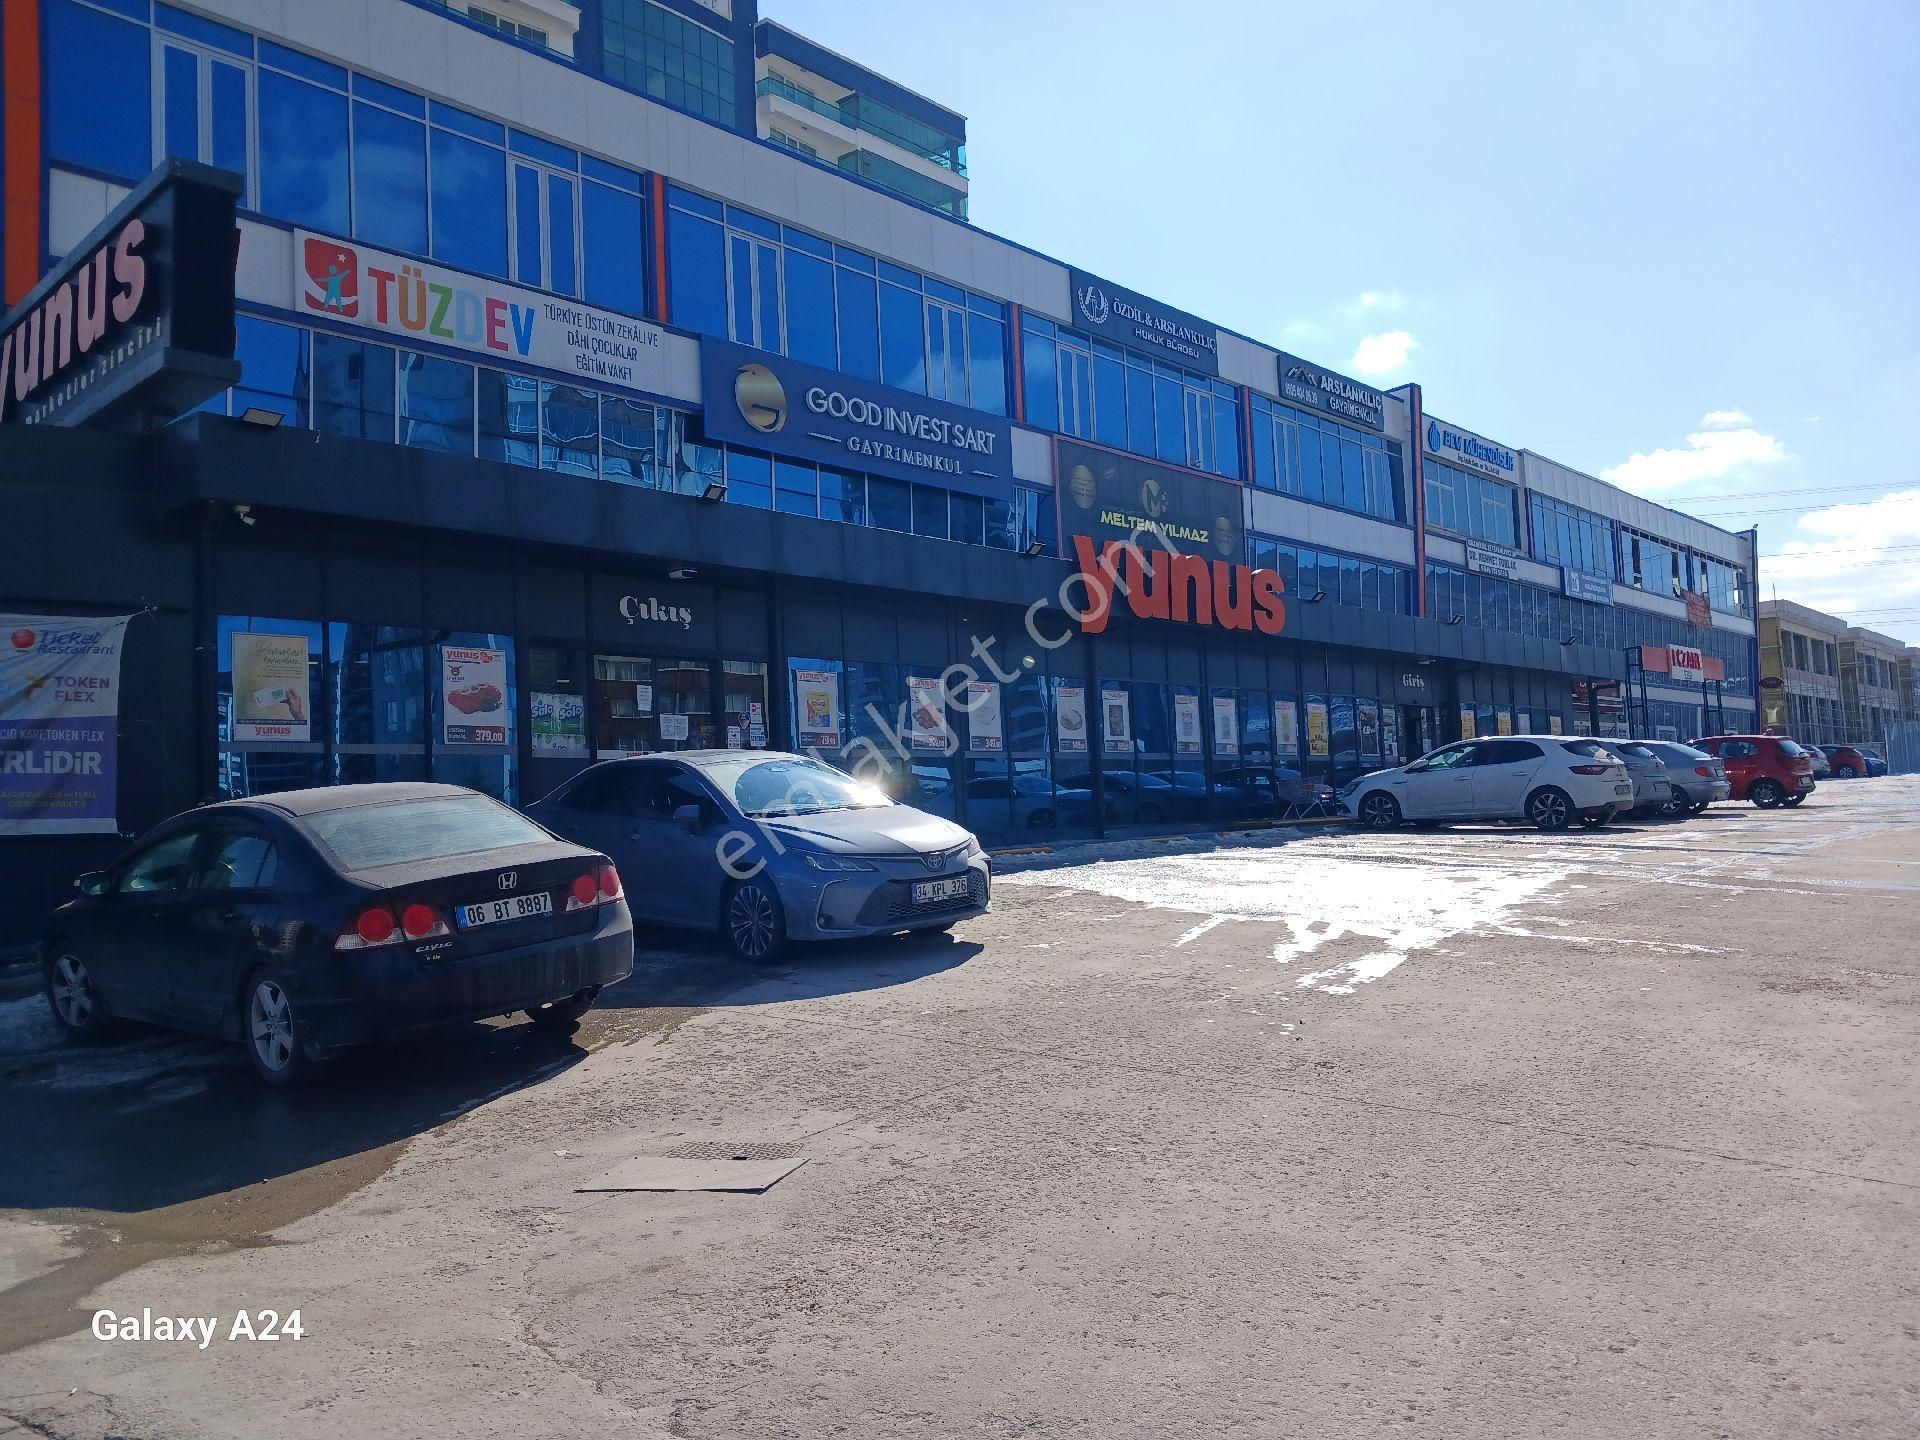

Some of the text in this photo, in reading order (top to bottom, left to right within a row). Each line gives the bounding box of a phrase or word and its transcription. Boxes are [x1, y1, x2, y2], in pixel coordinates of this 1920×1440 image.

[367, 265, 536, 357] TÜZDEV
[1112, 297, 1145, 324] ÖZDİL
[1144, 312, 1153, 327] &
[543, 303, 583, 328] TÜRKİYE
[647, 332, 658, 348] VE
[591, 337, 638, 362] ÇOCUKLAR
[1135, 327, 1200, 359] HUKUK BÜROSU
[575, 353, 632, 382] EĞİTİM VAKFI
[804, 386, 996, 456] GOOD INVEST SART
[1100, 510, 1209, 543] MELTEM YILMAZ
[1072, 534, 1287, 636] yunus
[619, 595, 692, 630] Çıkış
[38, 643, 115, 656] Restaurant
[39, 629, 101, 645] Ticket
[446, 650, 479, 660] yunus
[54, 676, 110, 689] TOKEN
[55, 690, 95, 703] FLEX
[81, 730, 105, 742] FLEX
[255, 726, 291, 736] yunus
[916, 879, 967, 898] 34 KPL 376
[467, 905, 486, 925] 06
[493, 900, 510, 920] BT
